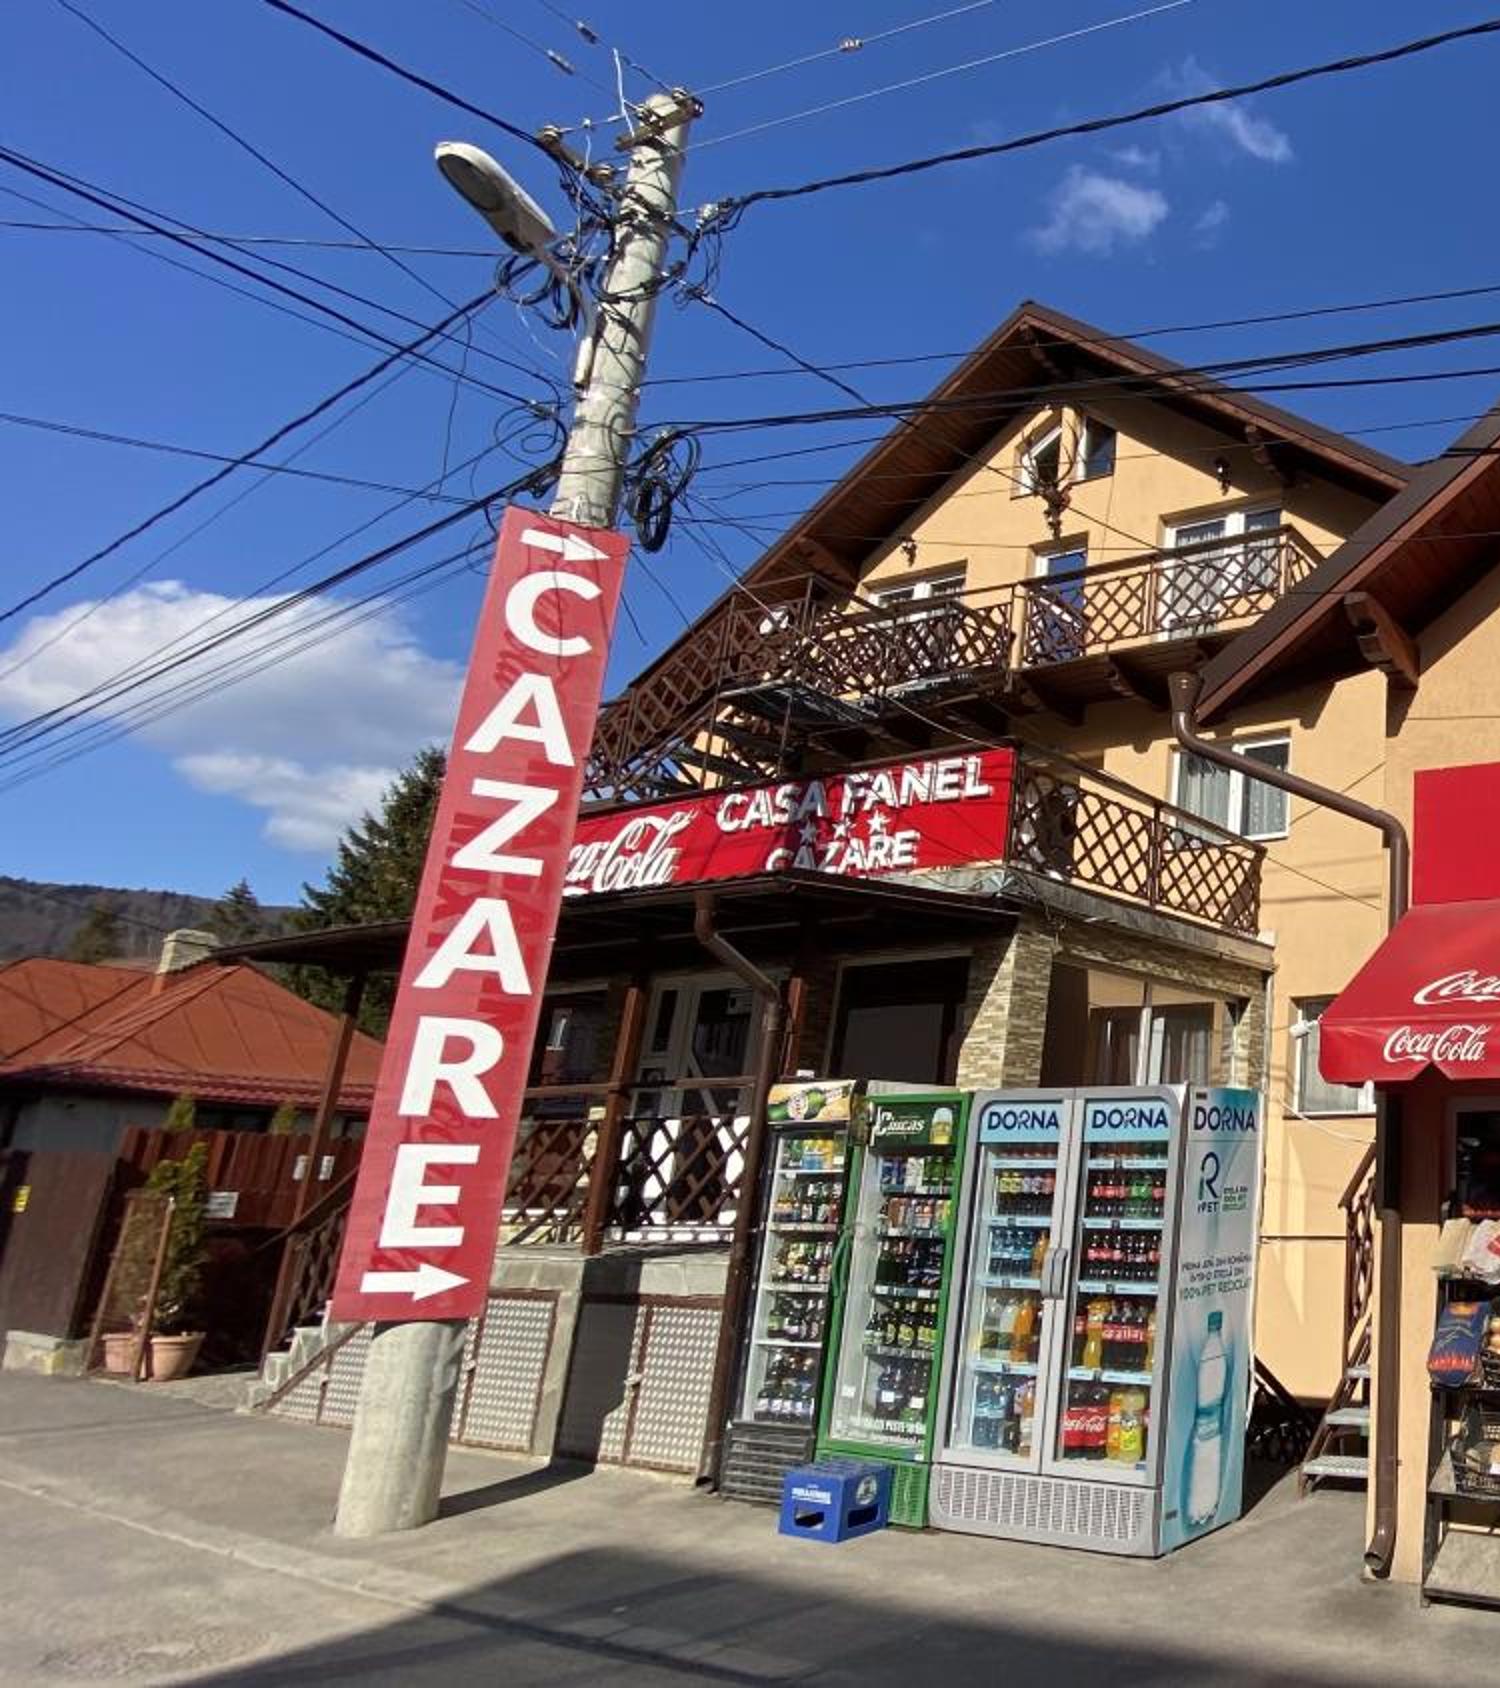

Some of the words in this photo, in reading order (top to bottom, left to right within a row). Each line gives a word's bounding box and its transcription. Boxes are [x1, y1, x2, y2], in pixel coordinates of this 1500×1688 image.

[715, 780, 827, 832] CASA
[840, 755, 992, 813] FANEL
[377, 570, 602, 1249] CAZARE
[1383, 1024, 1493, 1063] Coca-Cola
[987, 1109, 1059, 1131] DORNA
[1091, 1107, 1168, 1130] DORNA
[1193, 1106, 1256, 1132] DORNA
